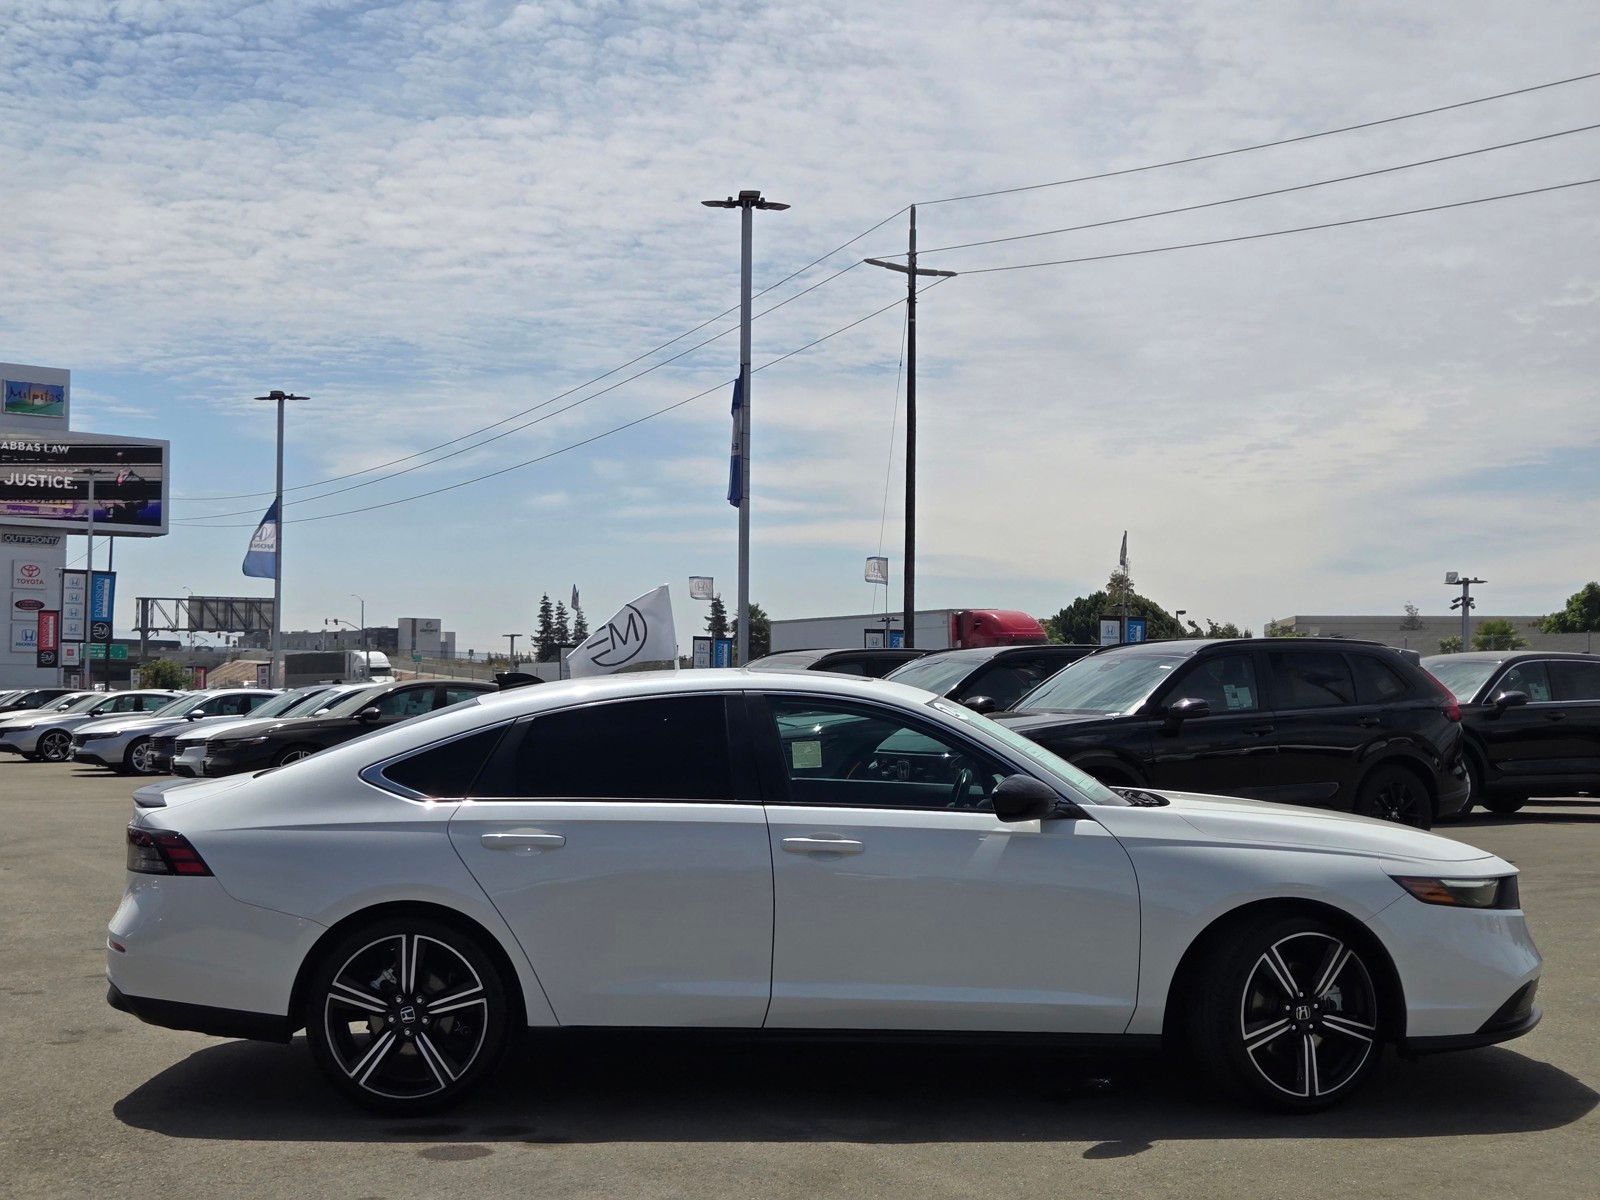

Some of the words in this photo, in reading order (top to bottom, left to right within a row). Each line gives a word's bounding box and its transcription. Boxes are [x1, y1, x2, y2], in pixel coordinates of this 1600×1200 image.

[1, 441, 41, 452] ABBAS
[44, 443, 70, 454] LAW
[4, 472, 78, 489] JUSTICE.
[95, 578, 104, 618] ENVISION
